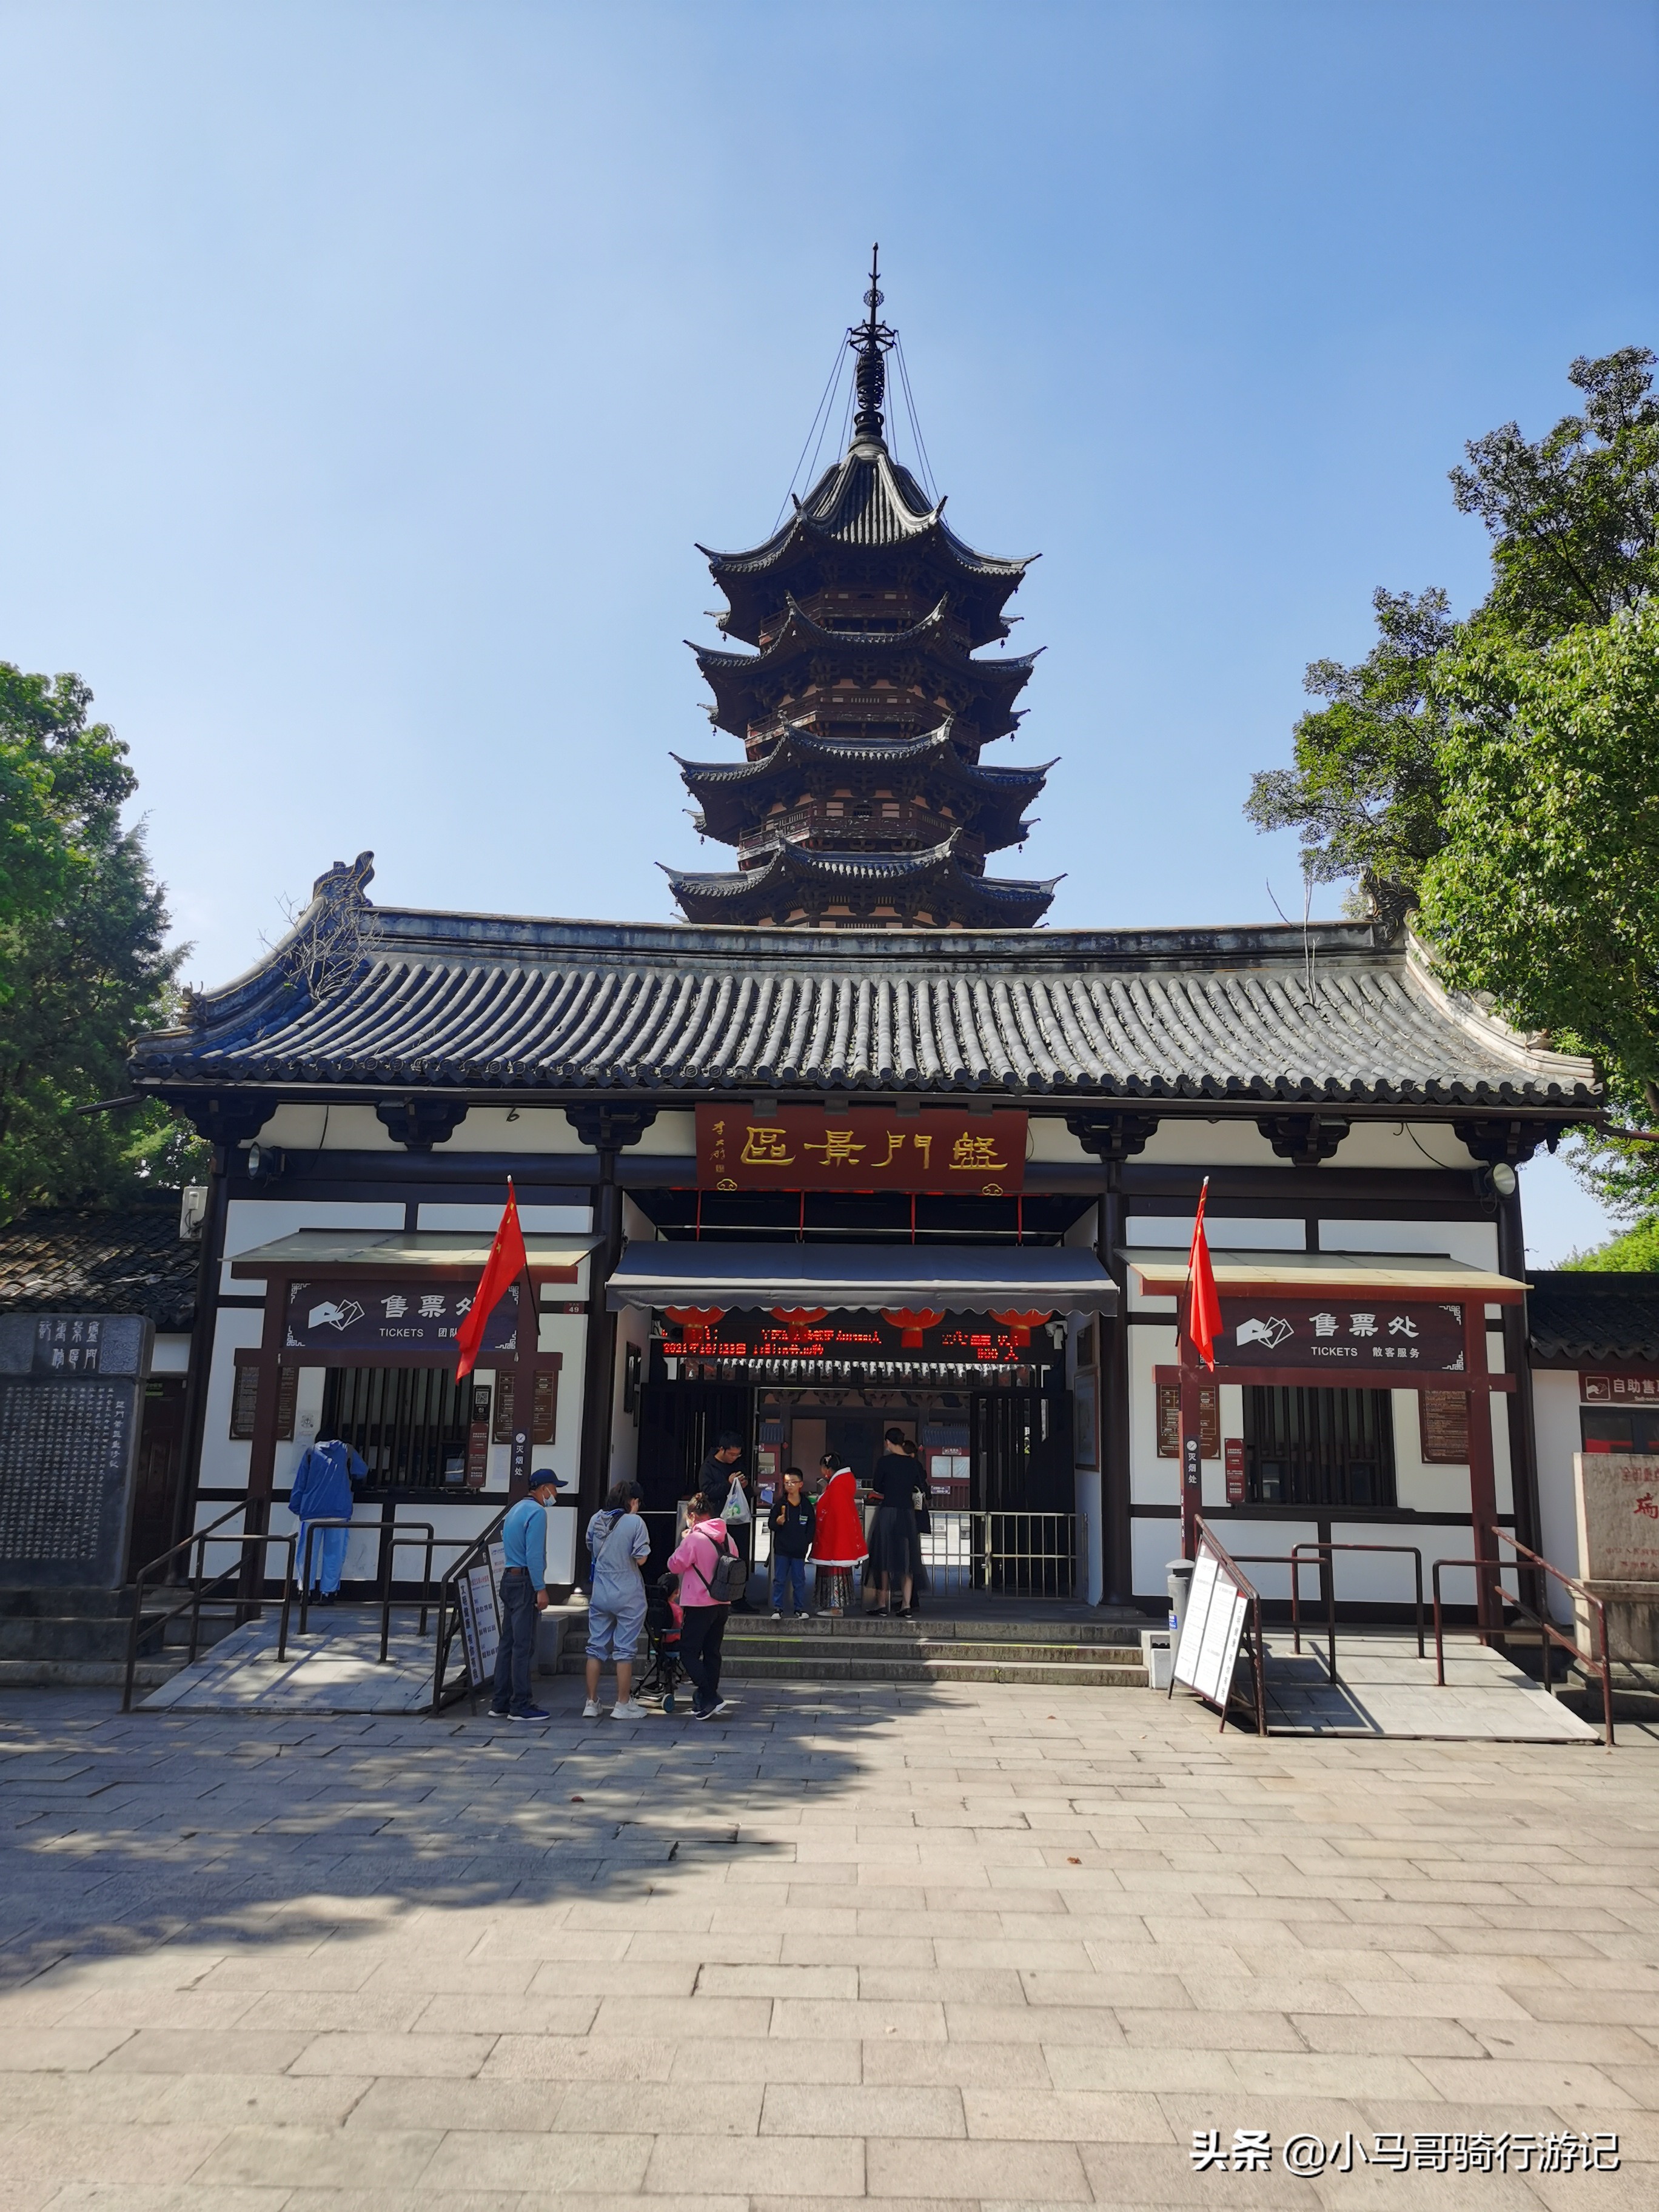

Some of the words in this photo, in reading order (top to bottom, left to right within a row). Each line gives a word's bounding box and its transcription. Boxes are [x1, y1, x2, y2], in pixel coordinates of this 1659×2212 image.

[379, 1328, 424, 1338] TICKETS
[1309, 1312, 1419, 1338] 售票处
[1311, 1346, 1358, 1357] TICKETS
[1372, 1347, 1420, 1358] 散客服务
[514, 1445, 525, 1476] 灭烟处
[1188, 1452, 1198, 1484] 灭烟处
